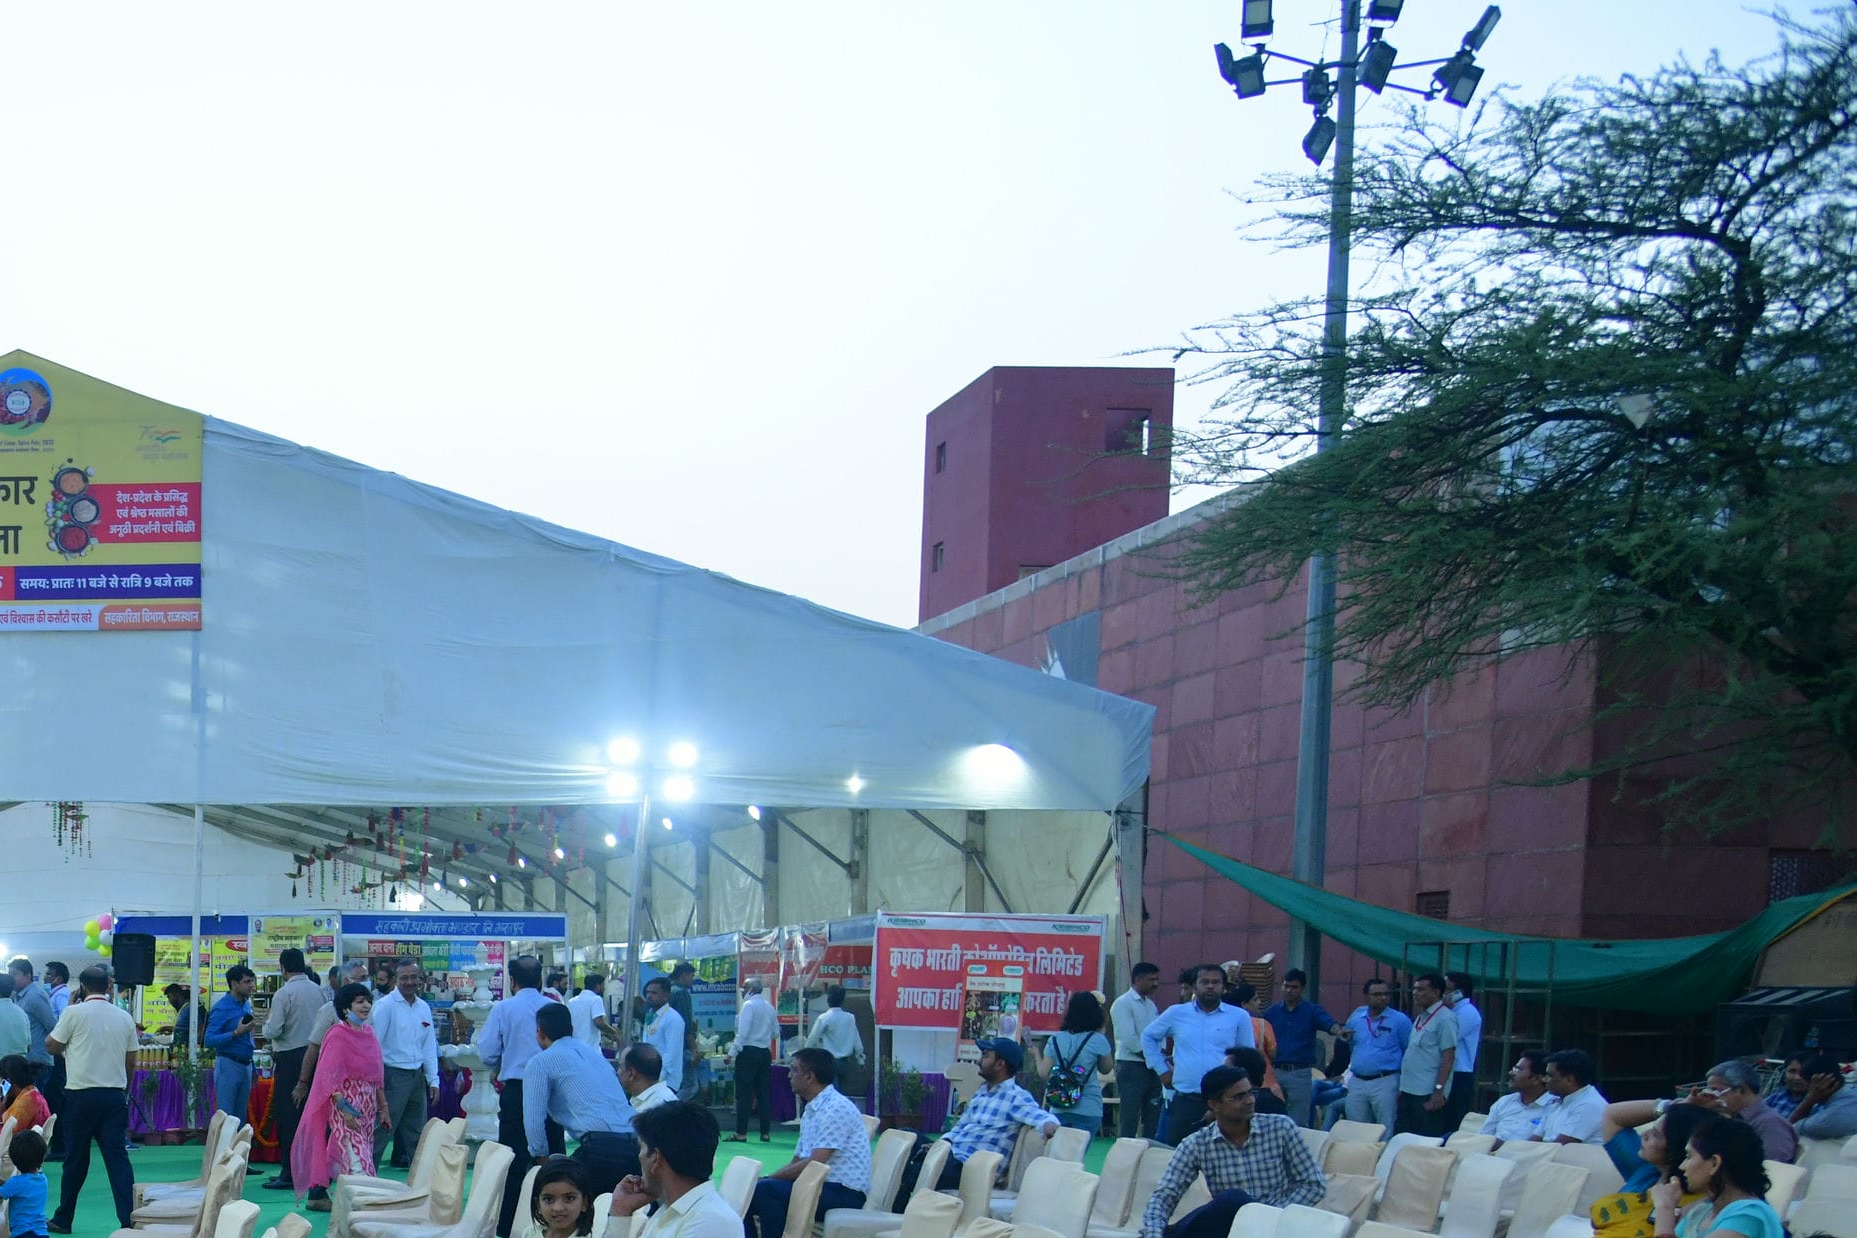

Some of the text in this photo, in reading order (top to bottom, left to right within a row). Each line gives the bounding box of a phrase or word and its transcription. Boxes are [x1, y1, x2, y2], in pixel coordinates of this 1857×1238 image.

[153, 490, 162, 502] के
[176, 504, 188, 517] की
[76, 577, 86, 588] 11
[88, 574, 107, 588] बजे
[108, 574, 118, 588] से
[120, 574, 142, 588] रात्रि
[144, 576, 151, 588] 9
[153, 573, 172, 588] बजे
[174, 576, 194, 587] तक
[36, 610, 46, 624] की
[72, 614, 80, 623] पर
[104, 608, 140, 625] सहकारिता
[167, 610, 198, 623] राजस्थान
[375, 919, 410, 934] सहकारी
[448, 920, 480, 934] भण्डार
[889, 946, 924, 977] कृषक
[926, 943, 961, 971] भारती
[1035, 946, 1084, 976] लिमिटेड
[820, 965, 844, 974] HCO
[896, 986, 940, 1010] आपका
[1024, 990, 1055, 1014] करता
